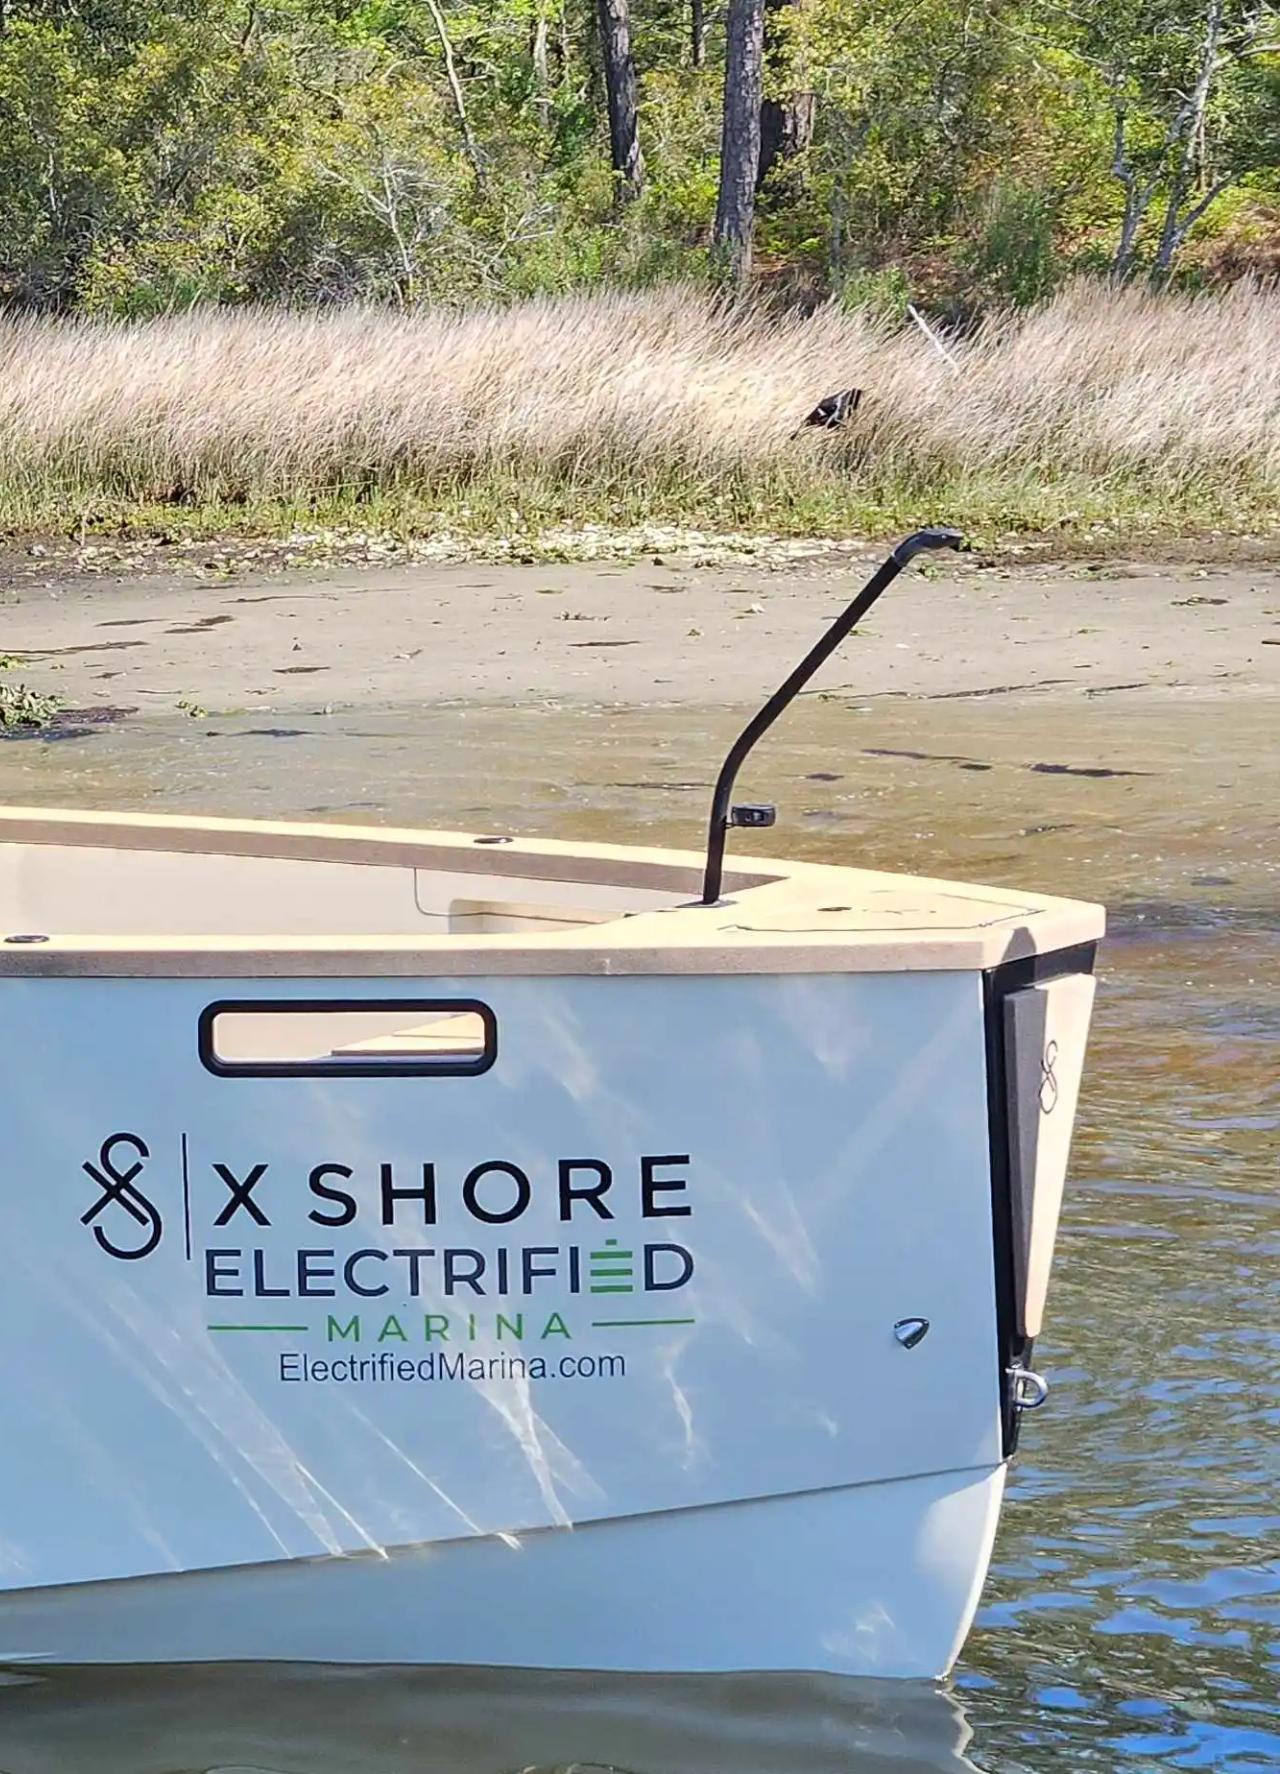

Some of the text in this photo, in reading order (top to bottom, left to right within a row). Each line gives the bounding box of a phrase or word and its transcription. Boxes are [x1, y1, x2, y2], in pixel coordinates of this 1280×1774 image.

[212, 1154, 693, 1228] X SHORE
[205, 1239, 695, 1298] ELECTRIFIED
[327, 1312, 572, 1343] MARINA
[279, 1352, 626, 1383] ElectrifiedMarina.com
